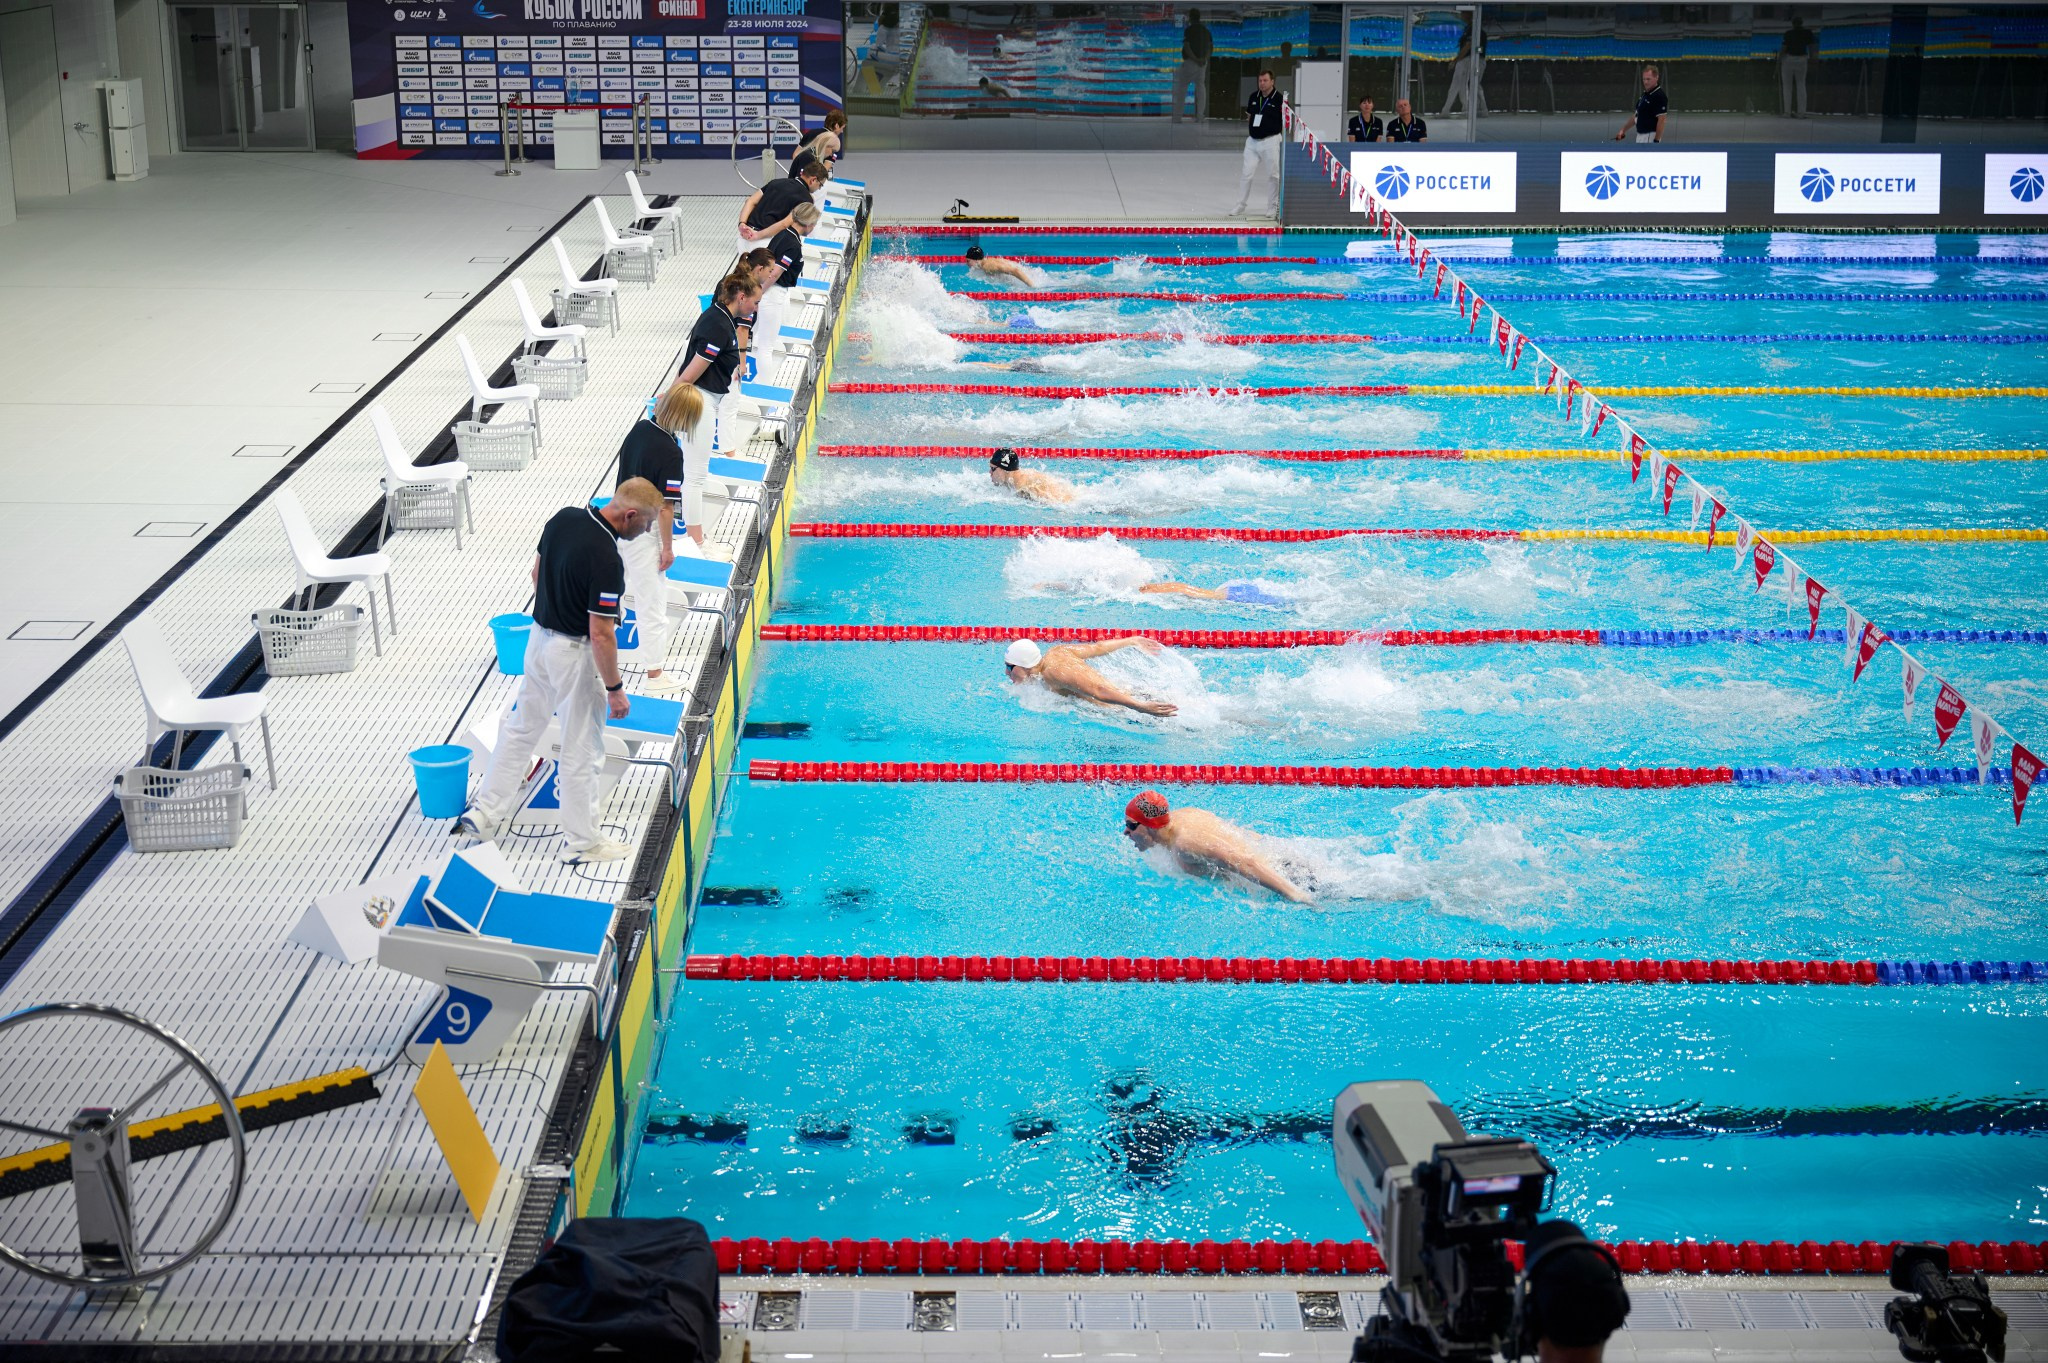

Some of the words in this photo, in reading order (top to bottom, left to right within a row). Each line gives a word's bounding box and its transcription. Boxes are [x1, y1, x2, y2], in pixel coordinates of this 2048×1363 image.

[525, 0, 575, 19] КУБОК
[581, 0, 642, 19] РОССИИ
[659, 0, 698, 16] ФИНАЛ
[728, 0, 807, 15] ЕКАТЕРИНБУРГ
[1416, 176, 1490, 189] РОССЕТИ
[1626, 176, 1700, 189] РОССЕТИ
[1841, 178, 1915, 192] РОССЕТИ
[1759, 543, 1772, 555] MAD
[1756, 550, 1773, 565] WAVE
[624, 620, 637, 643] 7
[1942, 690, 1958, 705] MAD
[1937, 698, 1961, 717] WAVE
[2018, 758, 2035, 775] MAD
[2015, 767, 2032, 787] WAVE
[446, 1002, 471, 1036] 9
